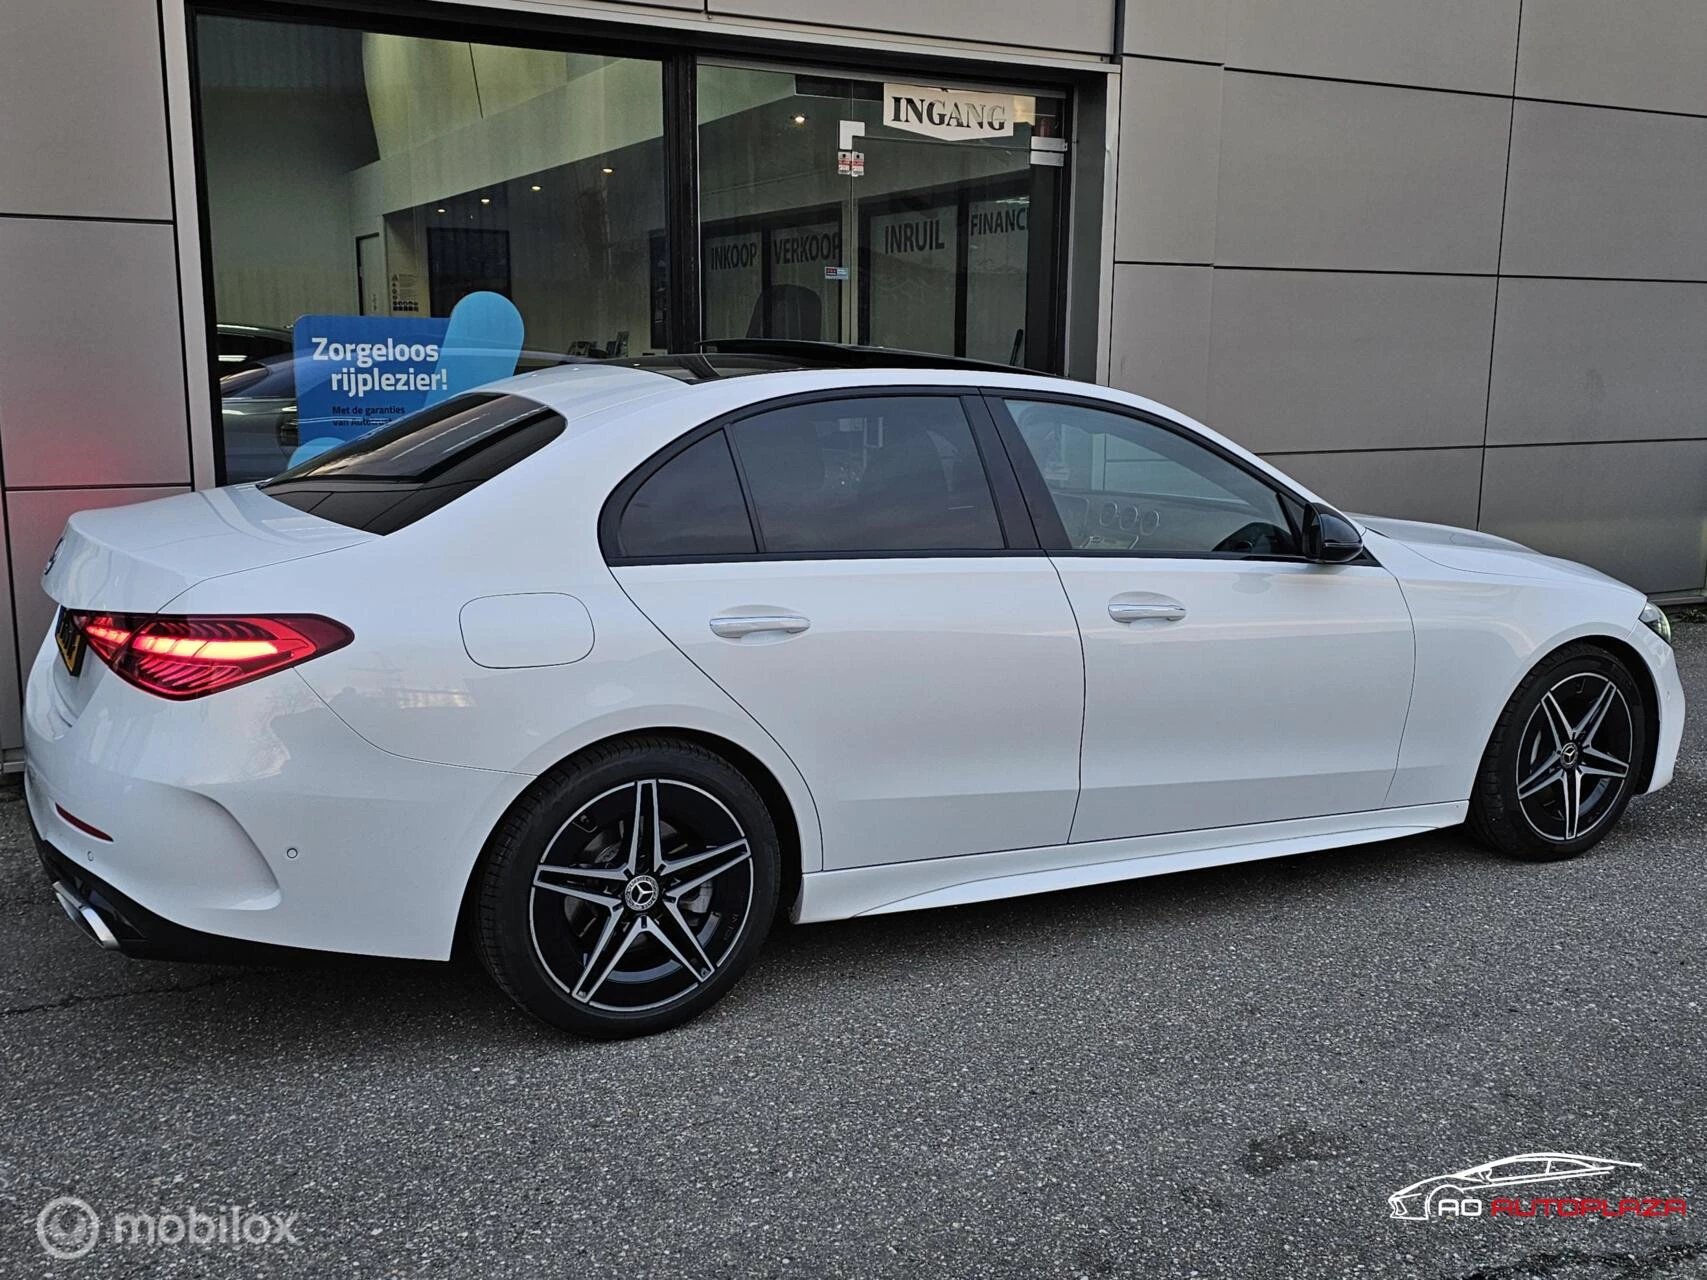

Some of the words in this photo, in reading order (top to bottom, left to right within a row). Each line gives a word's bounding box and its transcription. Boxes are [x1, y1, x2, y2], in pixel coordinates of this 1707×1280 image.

[891, 96, 1006, 131] INGANG
[970, 206, 1029, 236] FINANC
[884, 219, 945, 254] INRUIL
[710, 242, 757, 270] INKOOP
[311, 337, 439, 368] Zorgeloos
[331, 367, 448, 397] rijplezier!
[332, 406, 350, 415] Met
[352, 405, 363, 415] de
[365, 406, 406, 417] garanties
